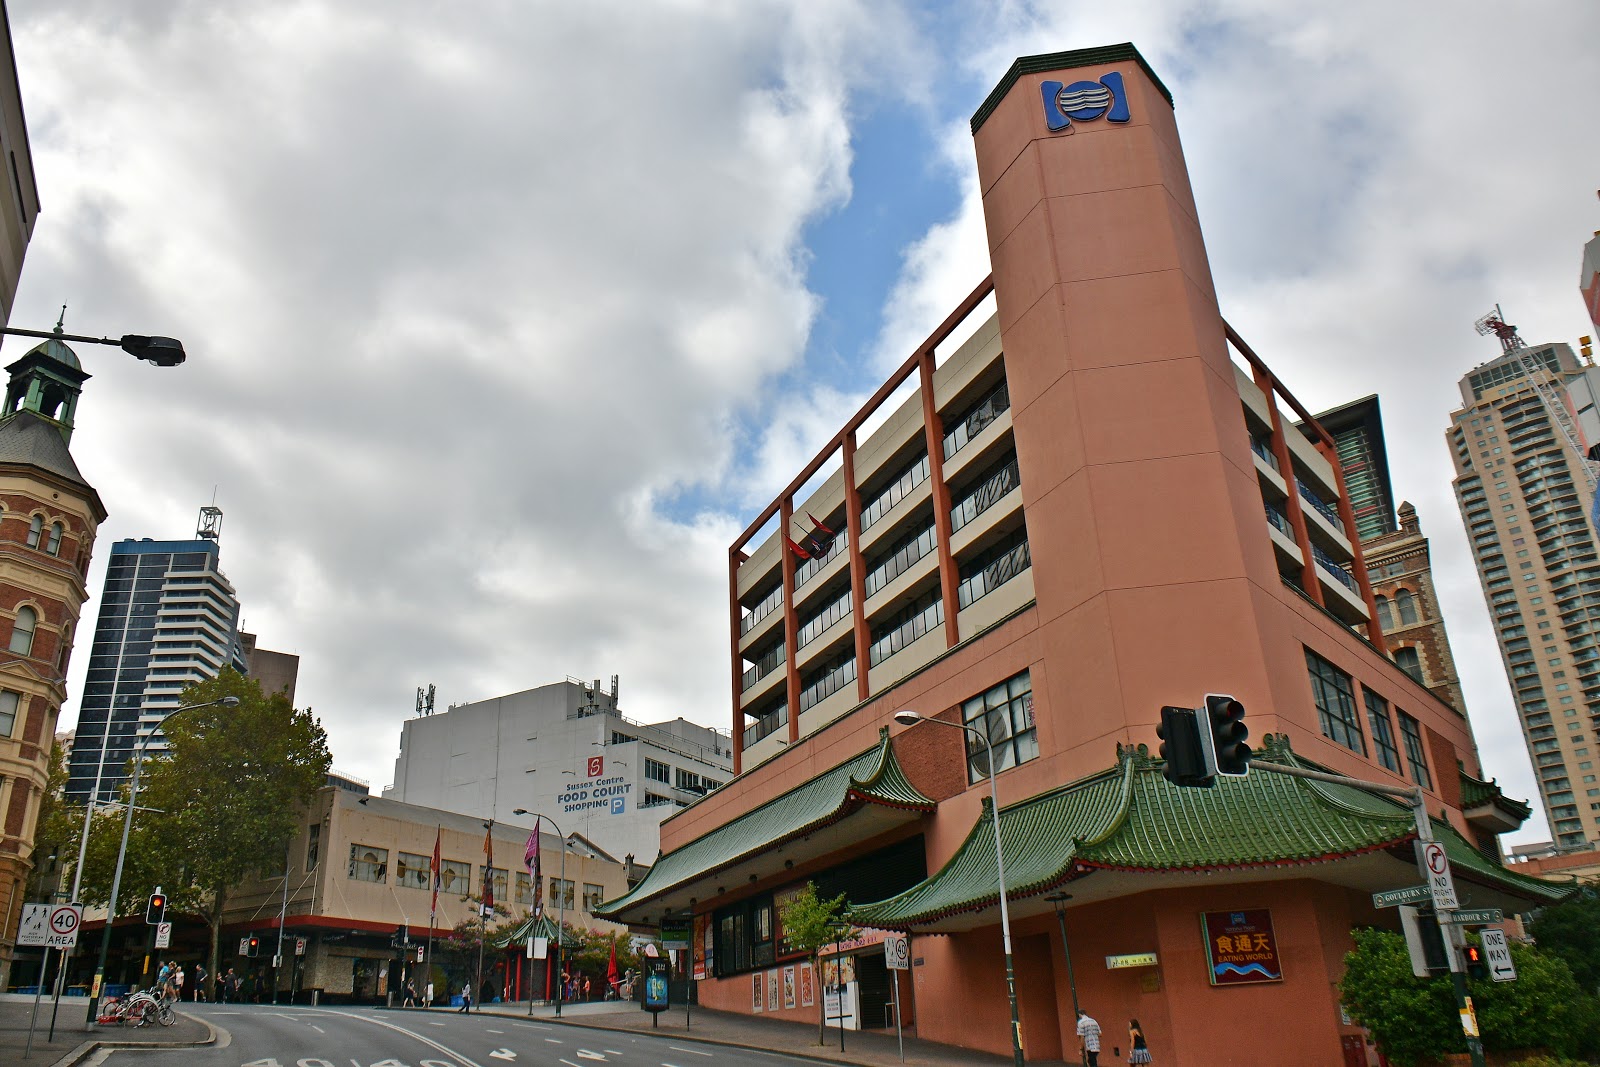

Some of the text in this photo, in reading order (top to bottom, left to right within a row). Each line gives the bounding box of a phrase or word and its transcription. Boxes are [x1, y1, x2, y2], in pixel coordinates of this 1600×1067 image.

[566, 776, 624, 791] Sussex Centre
[557, 783, 632, 803] FOOD COURT
[564, 799, 609, 812] SHOPPING
[1434, 877, 1447, 887] NO
[1385, 888, 1421, 902] GOULBURN
[1423, 886, 1432, 895] ST
[1433, 888, 1454, 897] RIGHT
[1436, 898, 1456, 906] TURN
[54, 914, 75, 928] 40
[1452, 914, 1481, 922] HARBOUR
[47, 935, 74, 945] AREA
[1216, 933, 1270, 954] 食通天
[1486, 933, 1503, 946] ONE
[897, 945, 906, 954] 40
[1488, 949, 1507, 962] WAY
[1218, 952, 1273, 963] EATING WORLD
